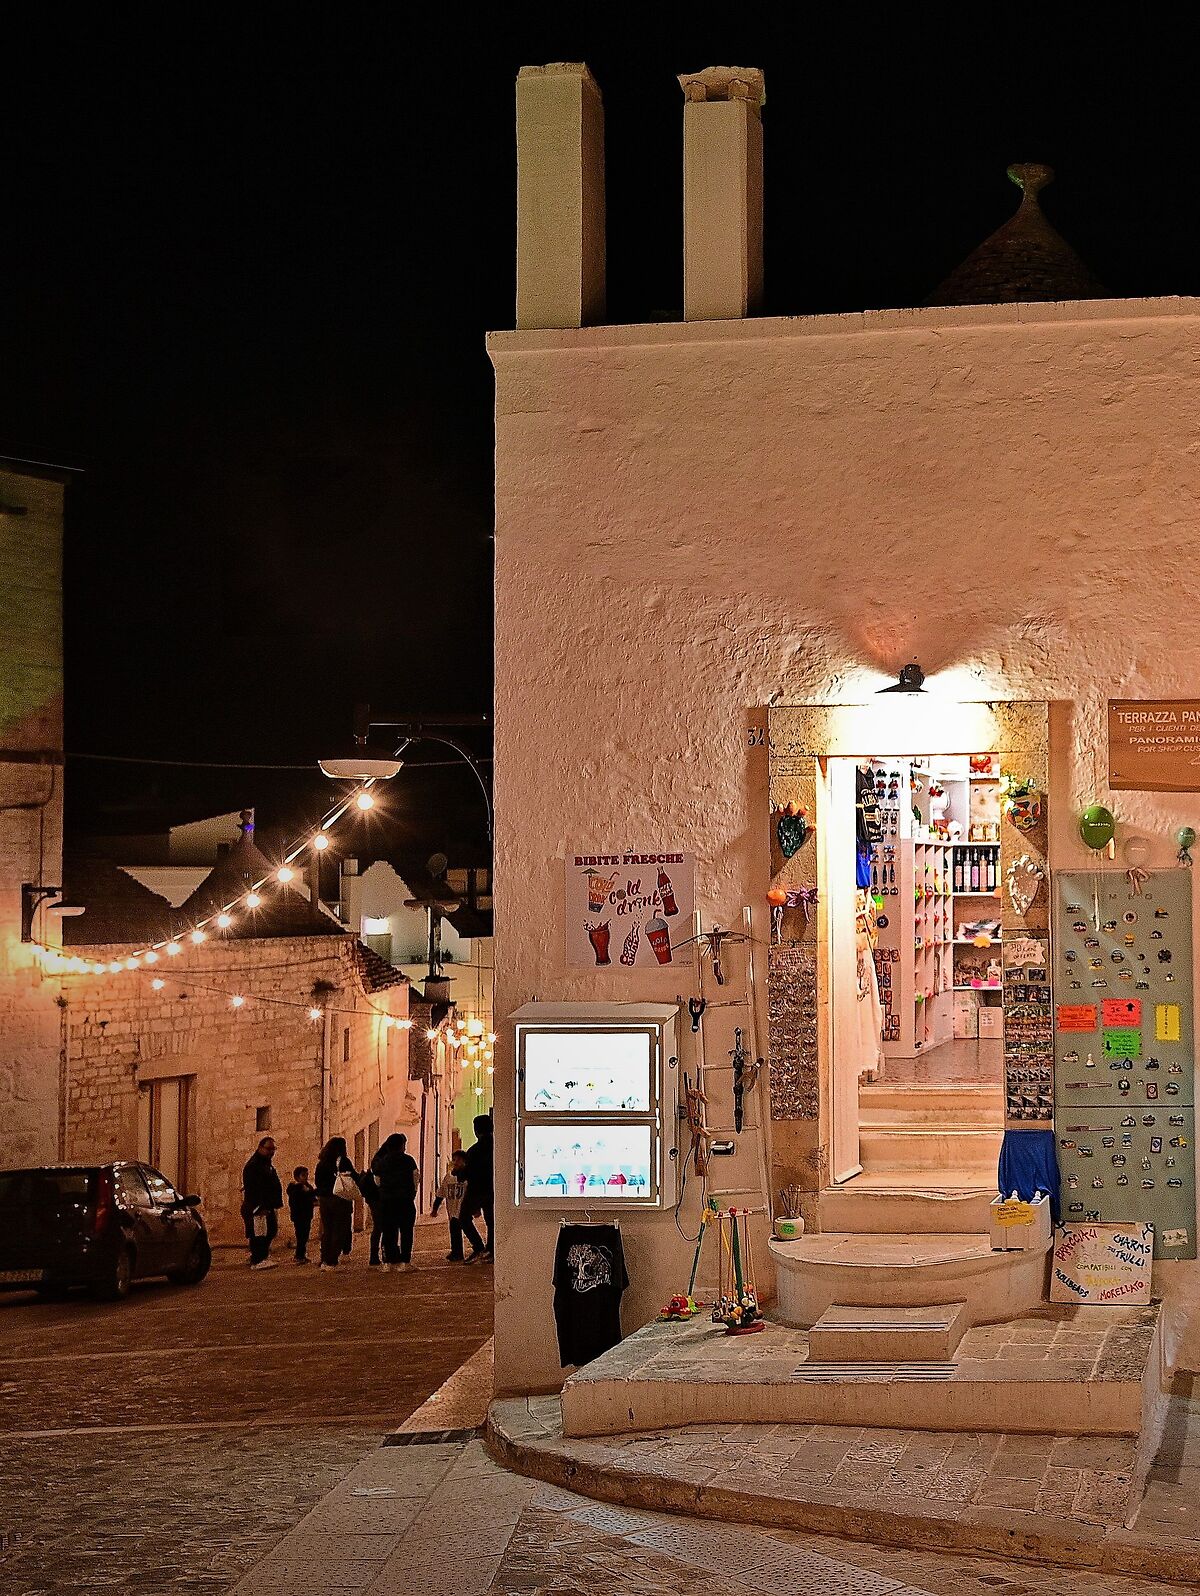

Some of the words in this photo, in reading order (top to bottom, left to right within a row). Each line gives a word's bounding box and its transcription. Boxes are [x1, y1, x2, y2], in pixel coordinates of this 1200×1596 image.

[1117, 710, 1178, 724] TERRAZZA
[747, 728, 765, 746] 34
[1129, 725, 1147, 733] PER
[1137, 745, 1157, 753] FOR
[1158, 744, 1183, 753] SHOP
[574, 855, 620, 866] BIBITE
[622, 853, 684, 865] FRESCHE
[1113, 1233, 1151, 1254] CHARMS
[1115, 1249, 1146, 1268] TRULLI
[1099, 1280, 1145, 1301] MORELLATO
